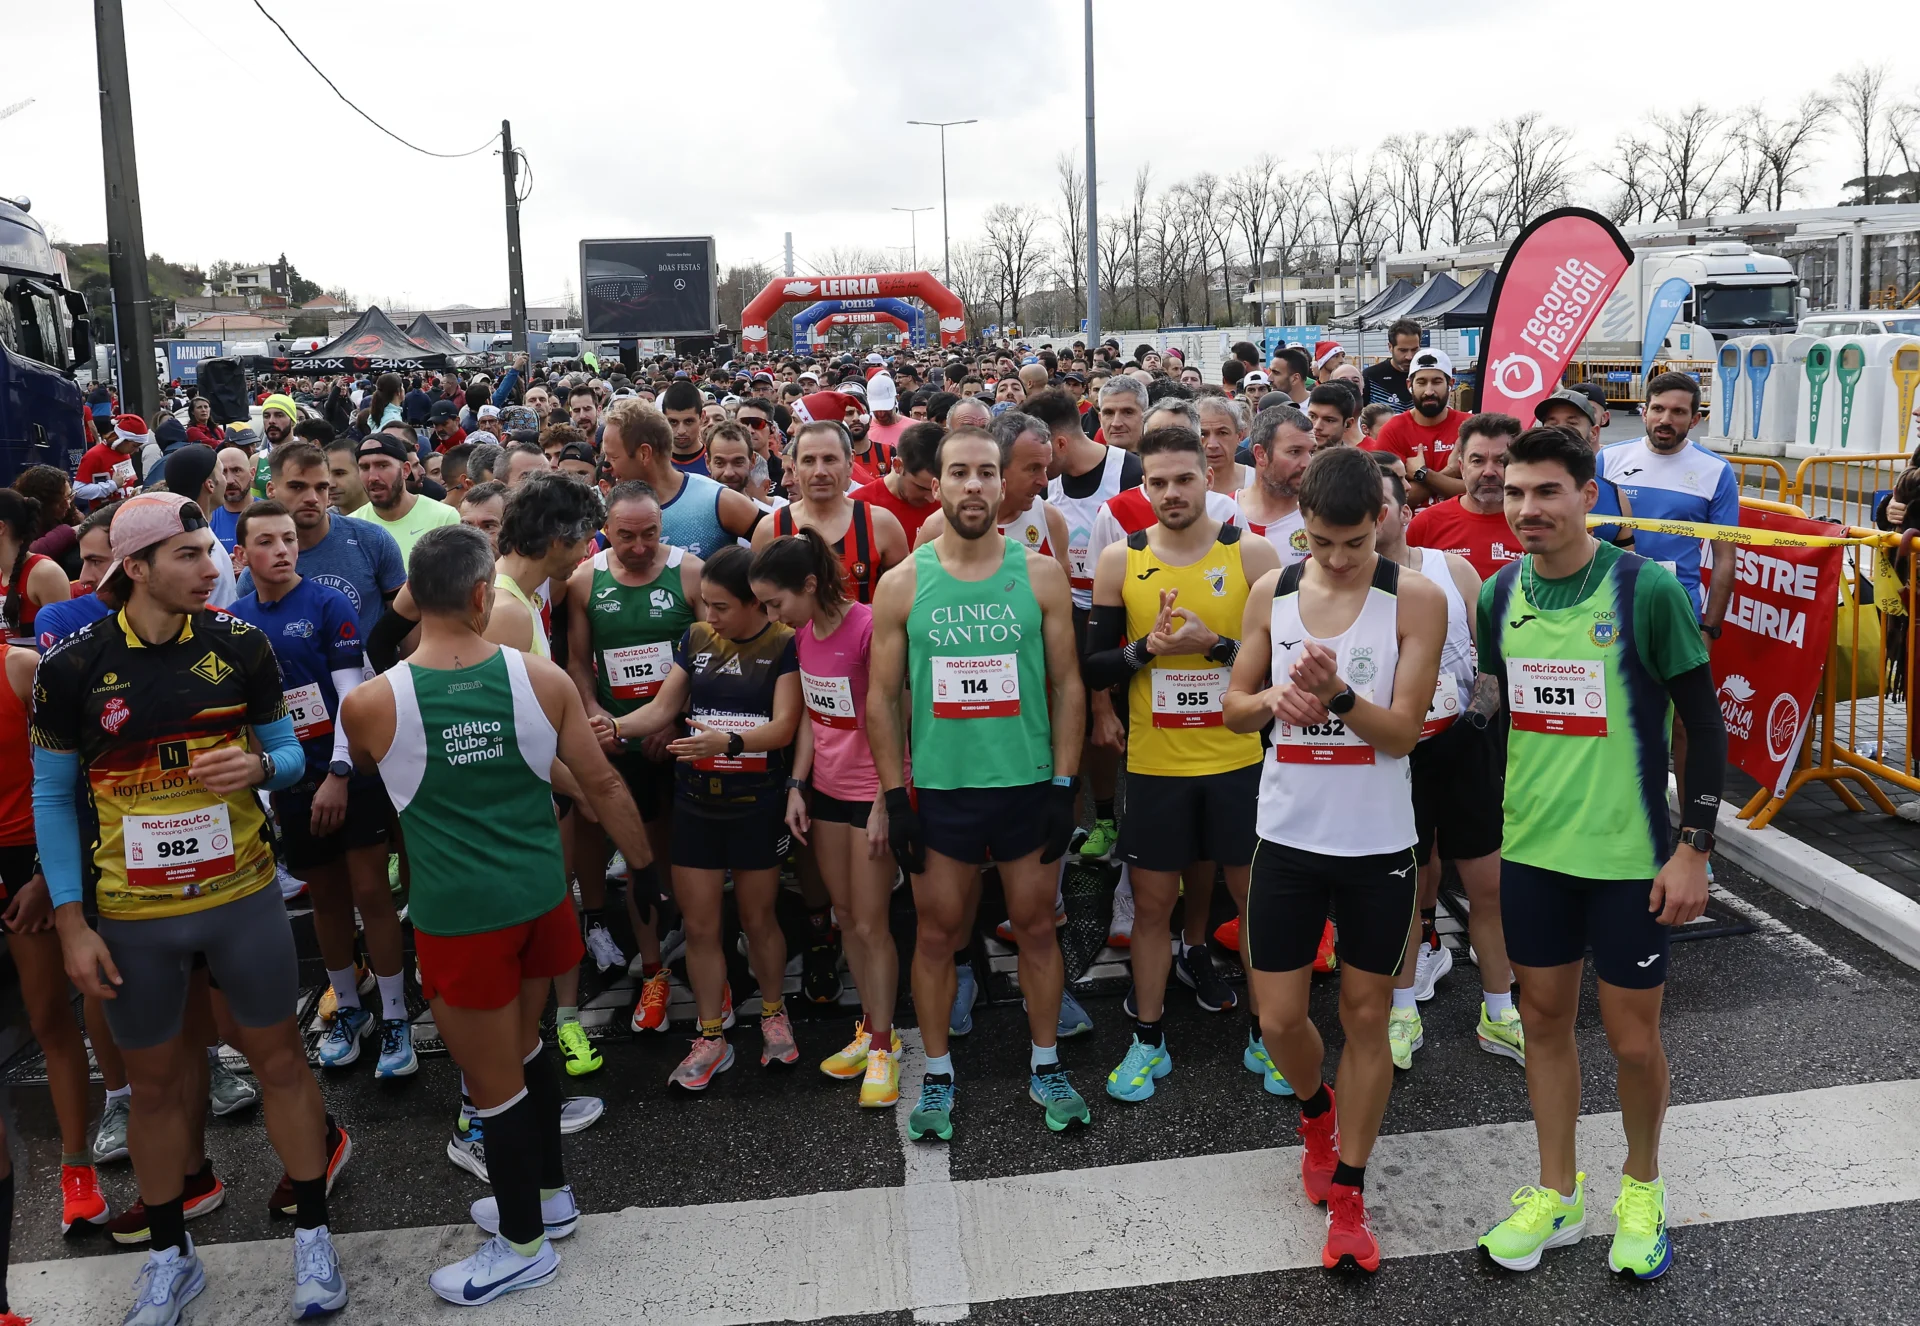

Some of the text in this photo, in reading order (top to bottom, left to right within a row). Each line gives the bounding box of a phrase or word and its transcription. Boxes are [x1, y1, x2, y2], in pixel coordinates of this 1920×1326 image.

[820, 278, 879, 296] LEIRIA
[1520, 258, 1584, 346] recorde
[848, 314, 876, 323] LEIRIA
[1536, 261, 1606, 362] pessoal
[176, 346, 216, 360] BATALHENSE
[291, 359, 344, 370] 24MX
[370, 358, 424, 368] 24MX
[1811, 375, 1820, 422] VIDRO
[1842, 376, 1851, 424] VIDRO
[1718, 530, 1751, 540] desporto
[931, 604, 1016, 624] CLINICA
[1724, 592, 1806, 649] LEIRIA
[928, 623, 1021, 647] SANTOS
[613, 646, 659, 659] matrizauto
[623, 663, 653, 679] 1152
[946, 658, 1002, 669] matrizauto
[1522, 663, 1585, 674] matrizauto
[804, 676, 836, 688] matrizauto
[1165, 673, 1220, 682] matrizauto
[92, 681, 131, 694] Lusosport
[961, 679, 989, 694] 114
[284, 690, 307, 701] zauto
[810, 692, 835, 709] 1445
[1177, 692, 1208, 706] 955
[1534, 687, 1574, 705] 1631
[101, 708, 130, 730] VIANA
[1720, 697, 1753, 730] eiria
[442, 721, 501, 739] atlético
[1302, 719, 1345, 736] 1632
[445, 736, 487, 753] clube
[447, 744, 503, 766] vermoil
[113, 781, 159, 797] HOTEL
[162, 776, 184, 789] DO
[181, 787, 208, 797] CASTELO
[142, 814, 210, 829] matrizauto
[156, 827, 182, 836] shopping
[157, 837, 199, 858] 982
